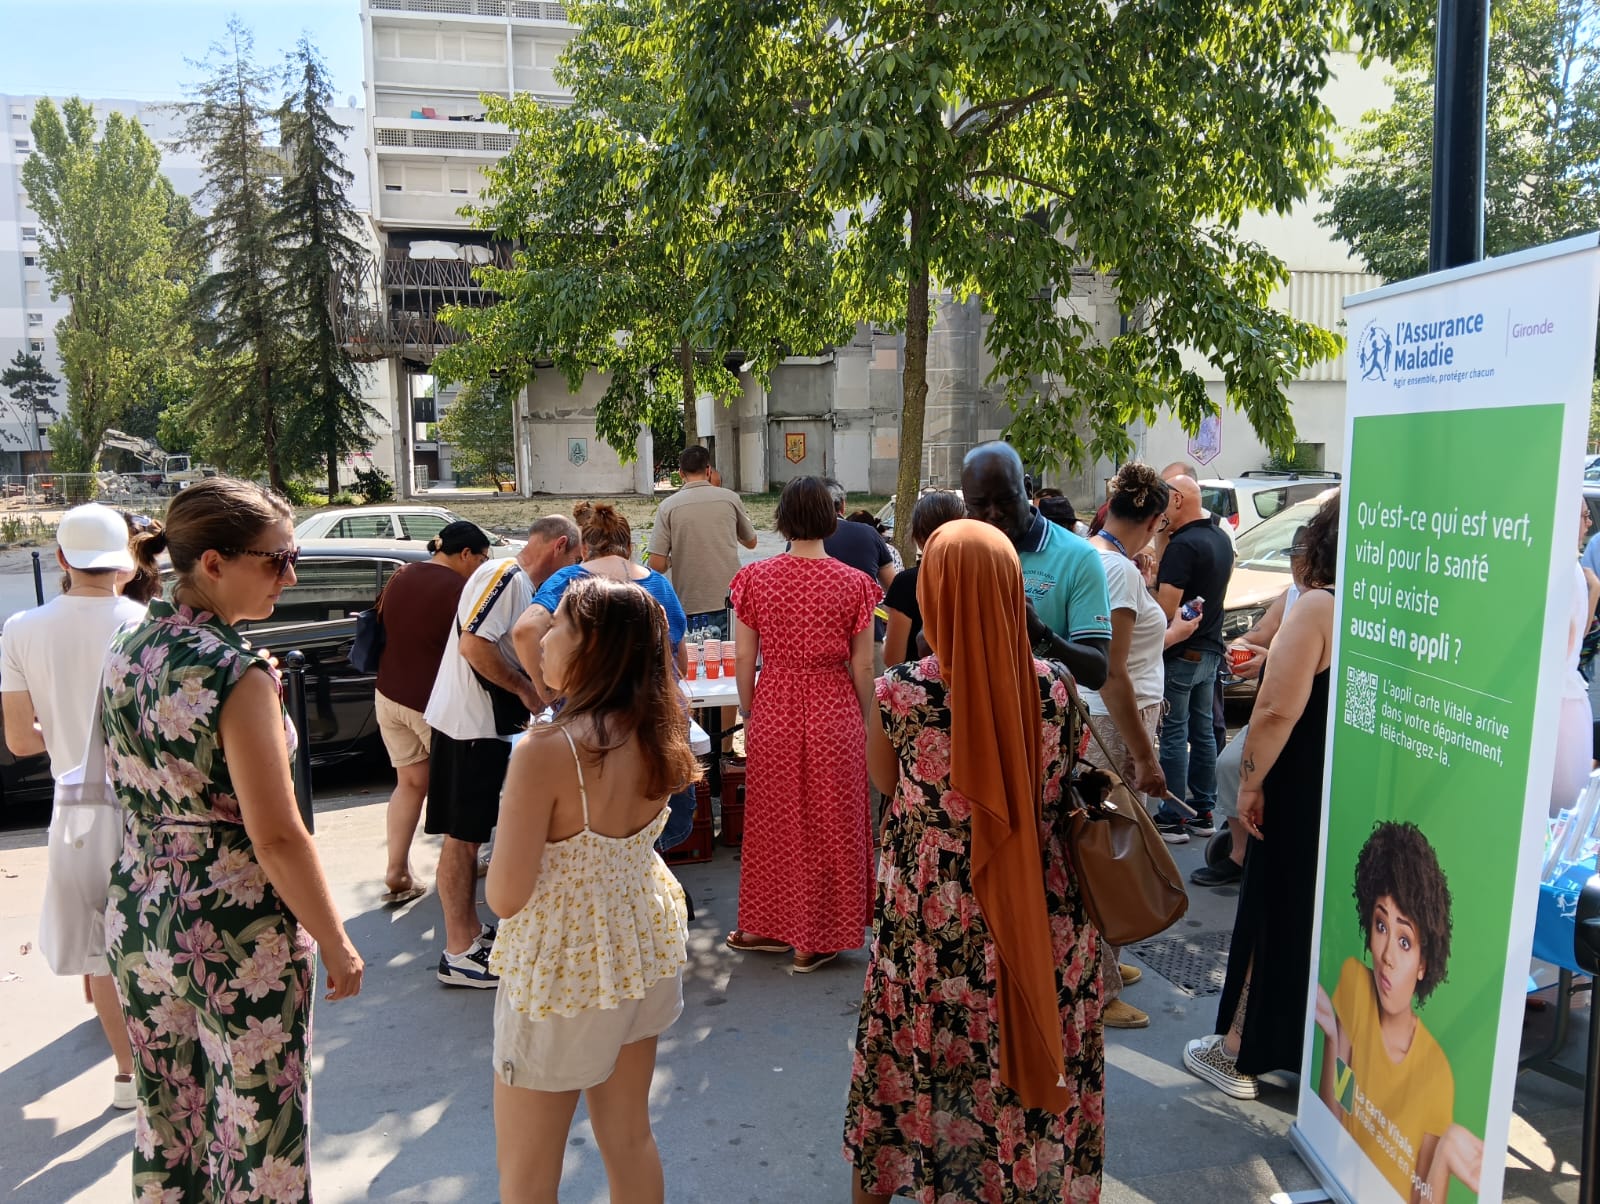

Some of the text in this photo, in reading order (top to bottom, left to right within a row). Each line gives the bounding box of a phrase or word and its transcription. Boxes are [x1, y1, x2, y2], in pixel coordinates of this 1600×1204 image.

[1396, 313, 1484, 346] l'Assurance
[1512, 318, 1554, 339] Gironde
[1393, 367, 1495, 389] Agir ensemble, protéger chacun
[1394, 341, 1454, 372] Maladie
[1357, 501, 1533, 547] Qu'est-ce qui est vert,
[1355, 539, 1489, 583] vital pour la santé
[1353, 577, 1440, 616] et qui existe
[1350, 617, 1462, 665] aussi en appli ?
[1382, 678, 1510, 740] L'appli carte Vitale arrive
[1379, 722, 1451, 767] téléchargez-la.
[1381, 701, 1504, 767] dans votre département,
